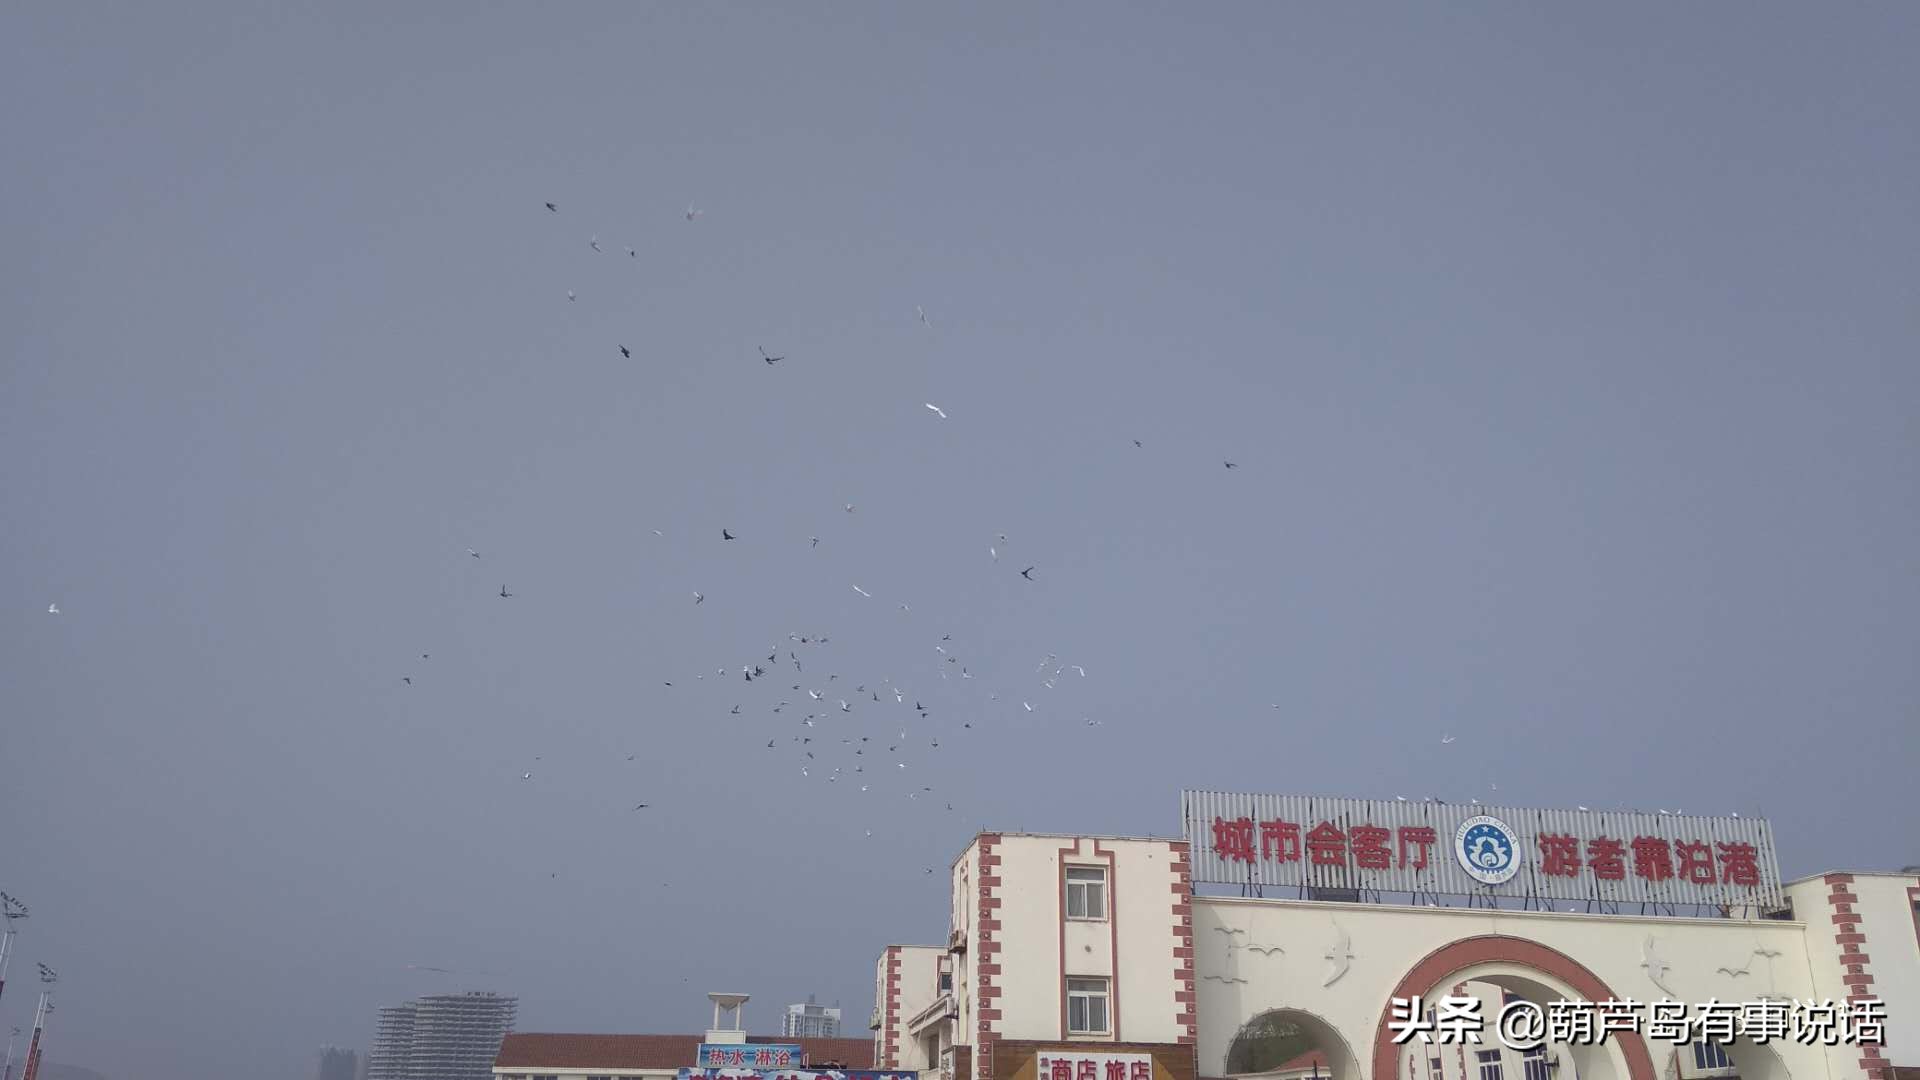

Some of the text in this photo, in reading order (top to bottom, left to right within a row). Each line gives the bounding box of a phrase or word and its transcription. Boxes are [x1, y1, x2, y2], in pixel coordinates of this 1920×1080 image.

[1213, 816, 1760, 886] 城市会客厅 游者靠泊港
[709, 1048, 791, 1065] 热水 淋浴
